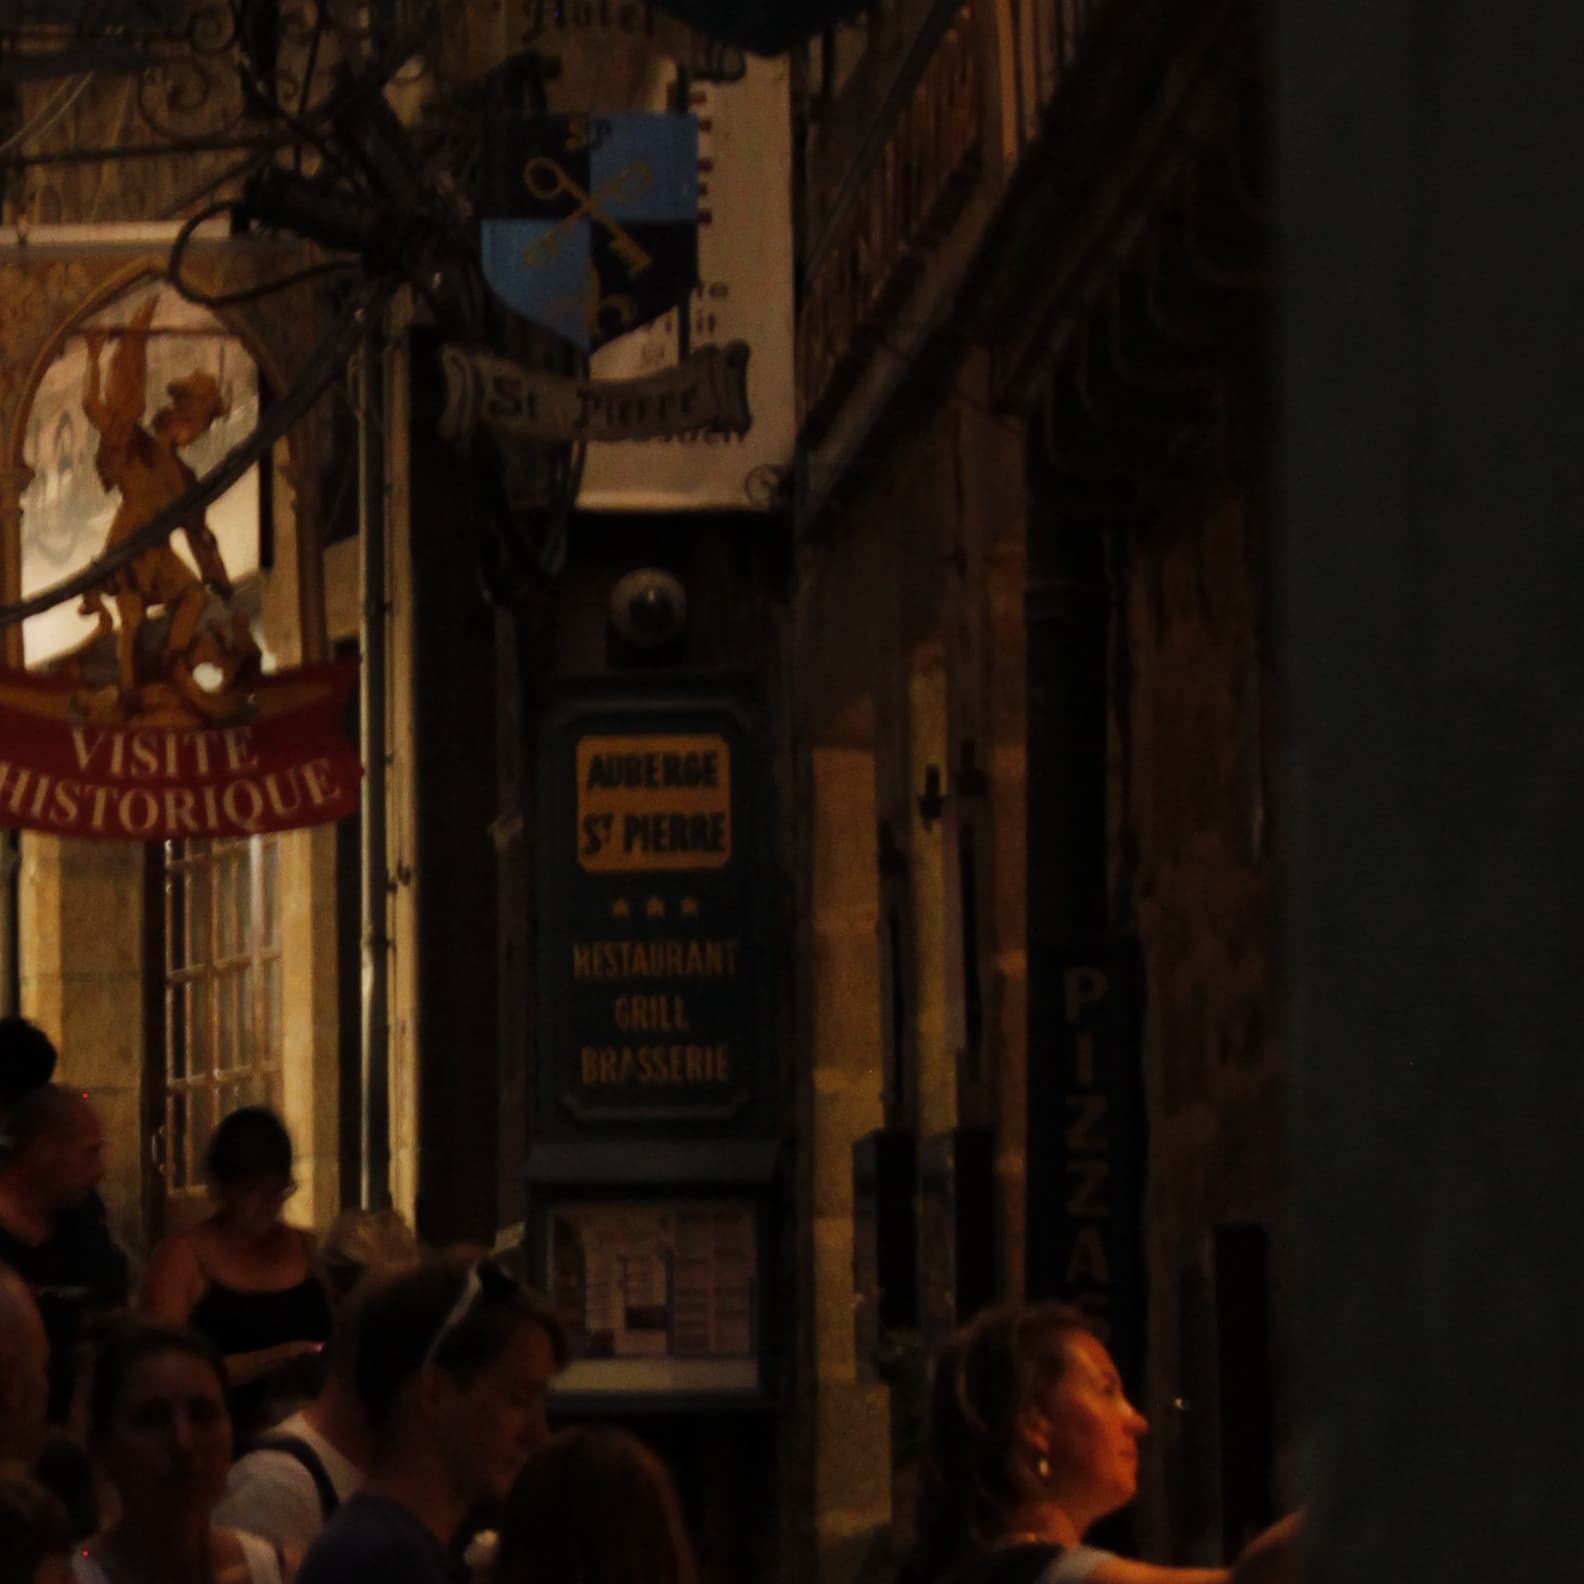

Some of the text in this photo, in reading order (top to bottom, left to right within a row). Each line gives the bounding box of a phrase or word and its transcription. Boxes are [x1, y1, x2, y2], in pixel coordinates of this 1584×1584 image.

[70, 724, 260, 778] VISITE
[587, 750, 720, 791] AUBERGE
[623, 809, 727, 855] PIERRE
[573, 938, 739, 982] RESTAURANT
[614, 993, 689, 1032] GRILL
[581, 1042, 729, 1085] BRASSERIE
